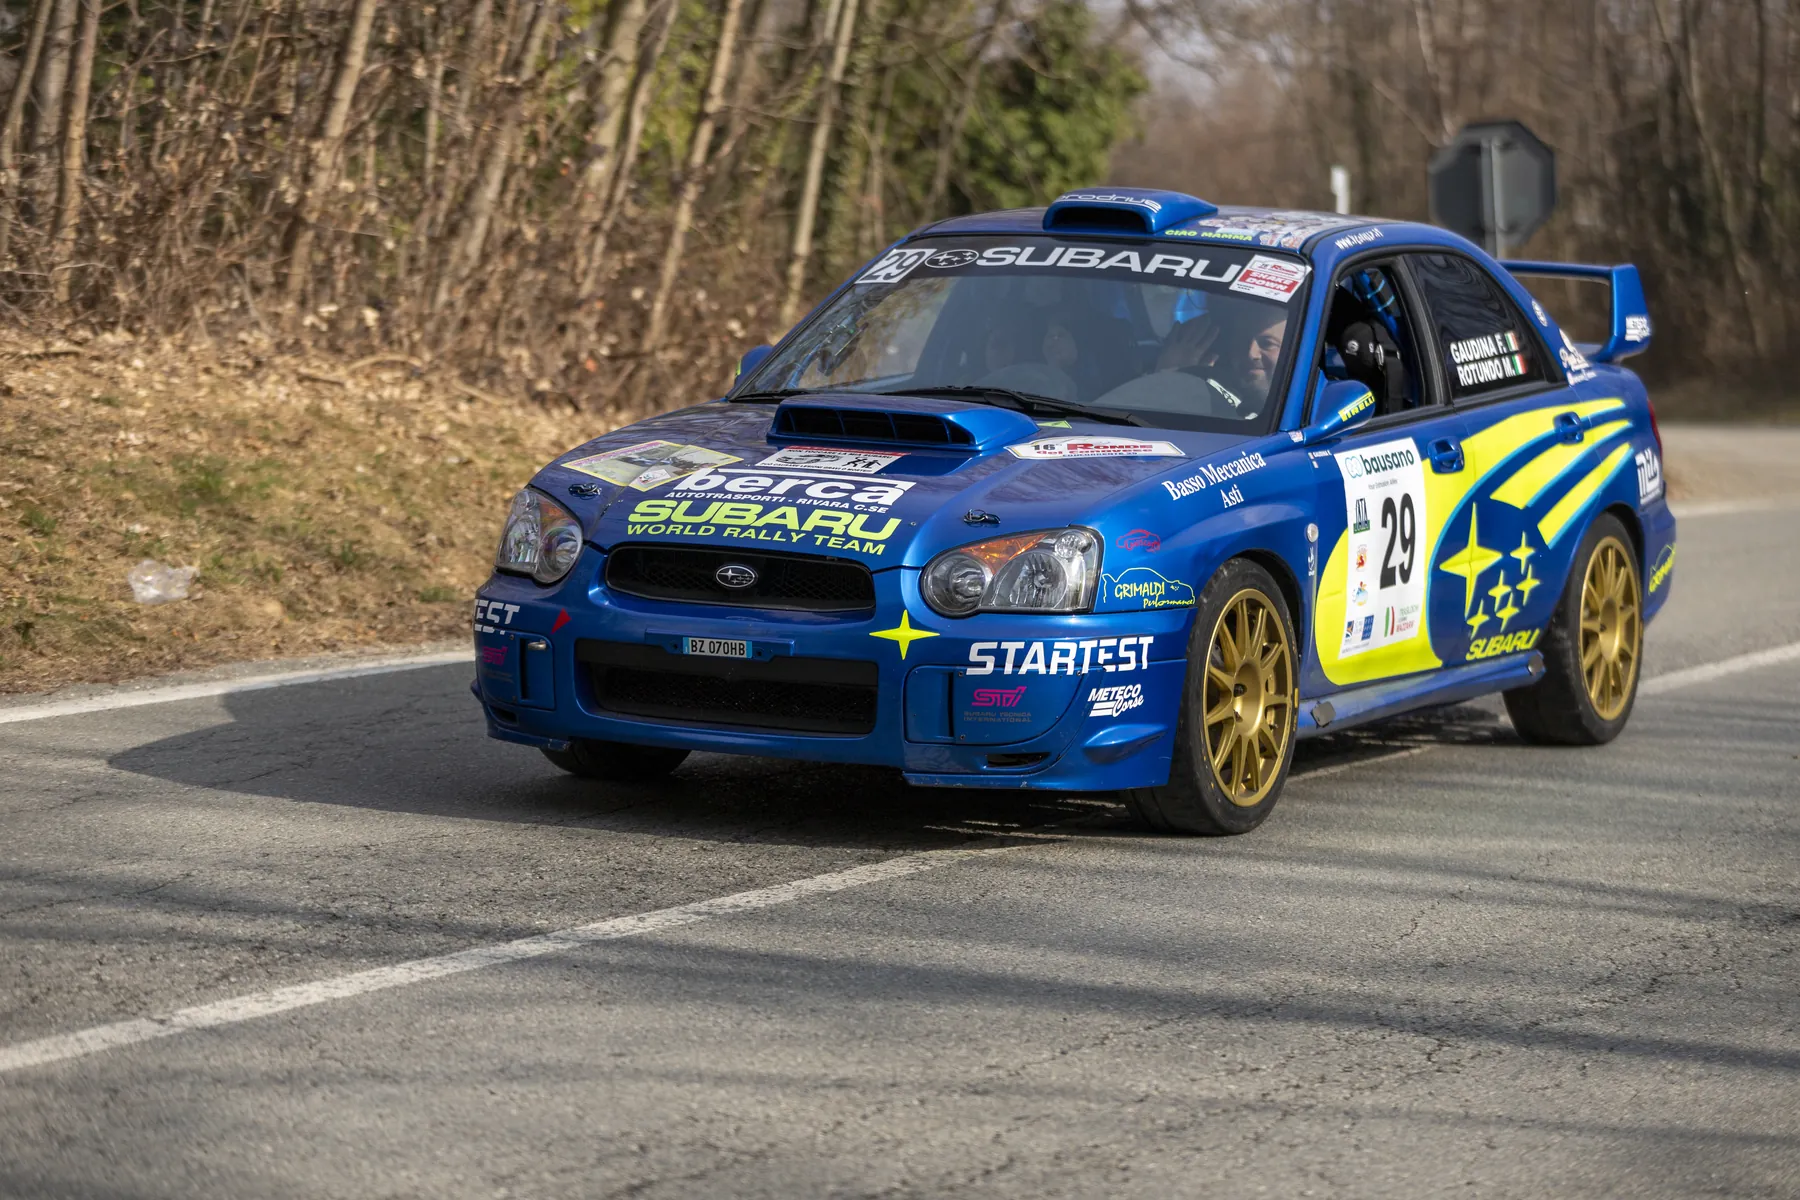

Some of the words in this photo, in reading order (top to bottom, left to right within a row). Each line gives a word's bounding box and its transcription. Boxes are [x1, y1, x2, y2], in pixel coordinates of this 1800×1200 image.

[1165, 229, 1198, 237] CIAO
[1201, 231, 1253, 241] MAMMA
[859, 251, 927, 281] 29
[976, 247, 1242, 283] SUBARU
[1249, 271, 1294, 284] SHAKE
[1245, 277, 1288, 291] DOWN
[1450, 336, 1498, 364] GAUDINA
[1456, 359, 1503, 387] ROTUNDO
[1162, 471, 1208, 501] Basso
[1200, 450, 1267, 485] Meccanica
[1361, 449, 1414, 475] bausano
[672, 467, 917, 507] berca
[1220, 484, 1245, 508] Asti
[664, 491, 787, 504] AUTOTRASPORTI
[796, 497, 850, 511] RIVARA
[853, 503, 889, 515] C.SE
[628, 499, 901, 541] SUBARU
[626, 523, 716, 536] WORLD
[722, 527, 807, 543] RALLY
[814, 534, 886, 556] TEAM
[1380, 493, 1416, 590] 29
[1114, 581, 1165, 600] GRIMALDI
[475, 599, 520, 635] EST
[691, 639, 705, 653] BZ
[708, 640, 745, 657] 070HB
[966, 635, 1154, 676] STARTEST
[1466, 629, 1540, 661] SUBARU
[1088, 683, 1141, 702] METECO
[1111, 695, 1144, 718] Corse
